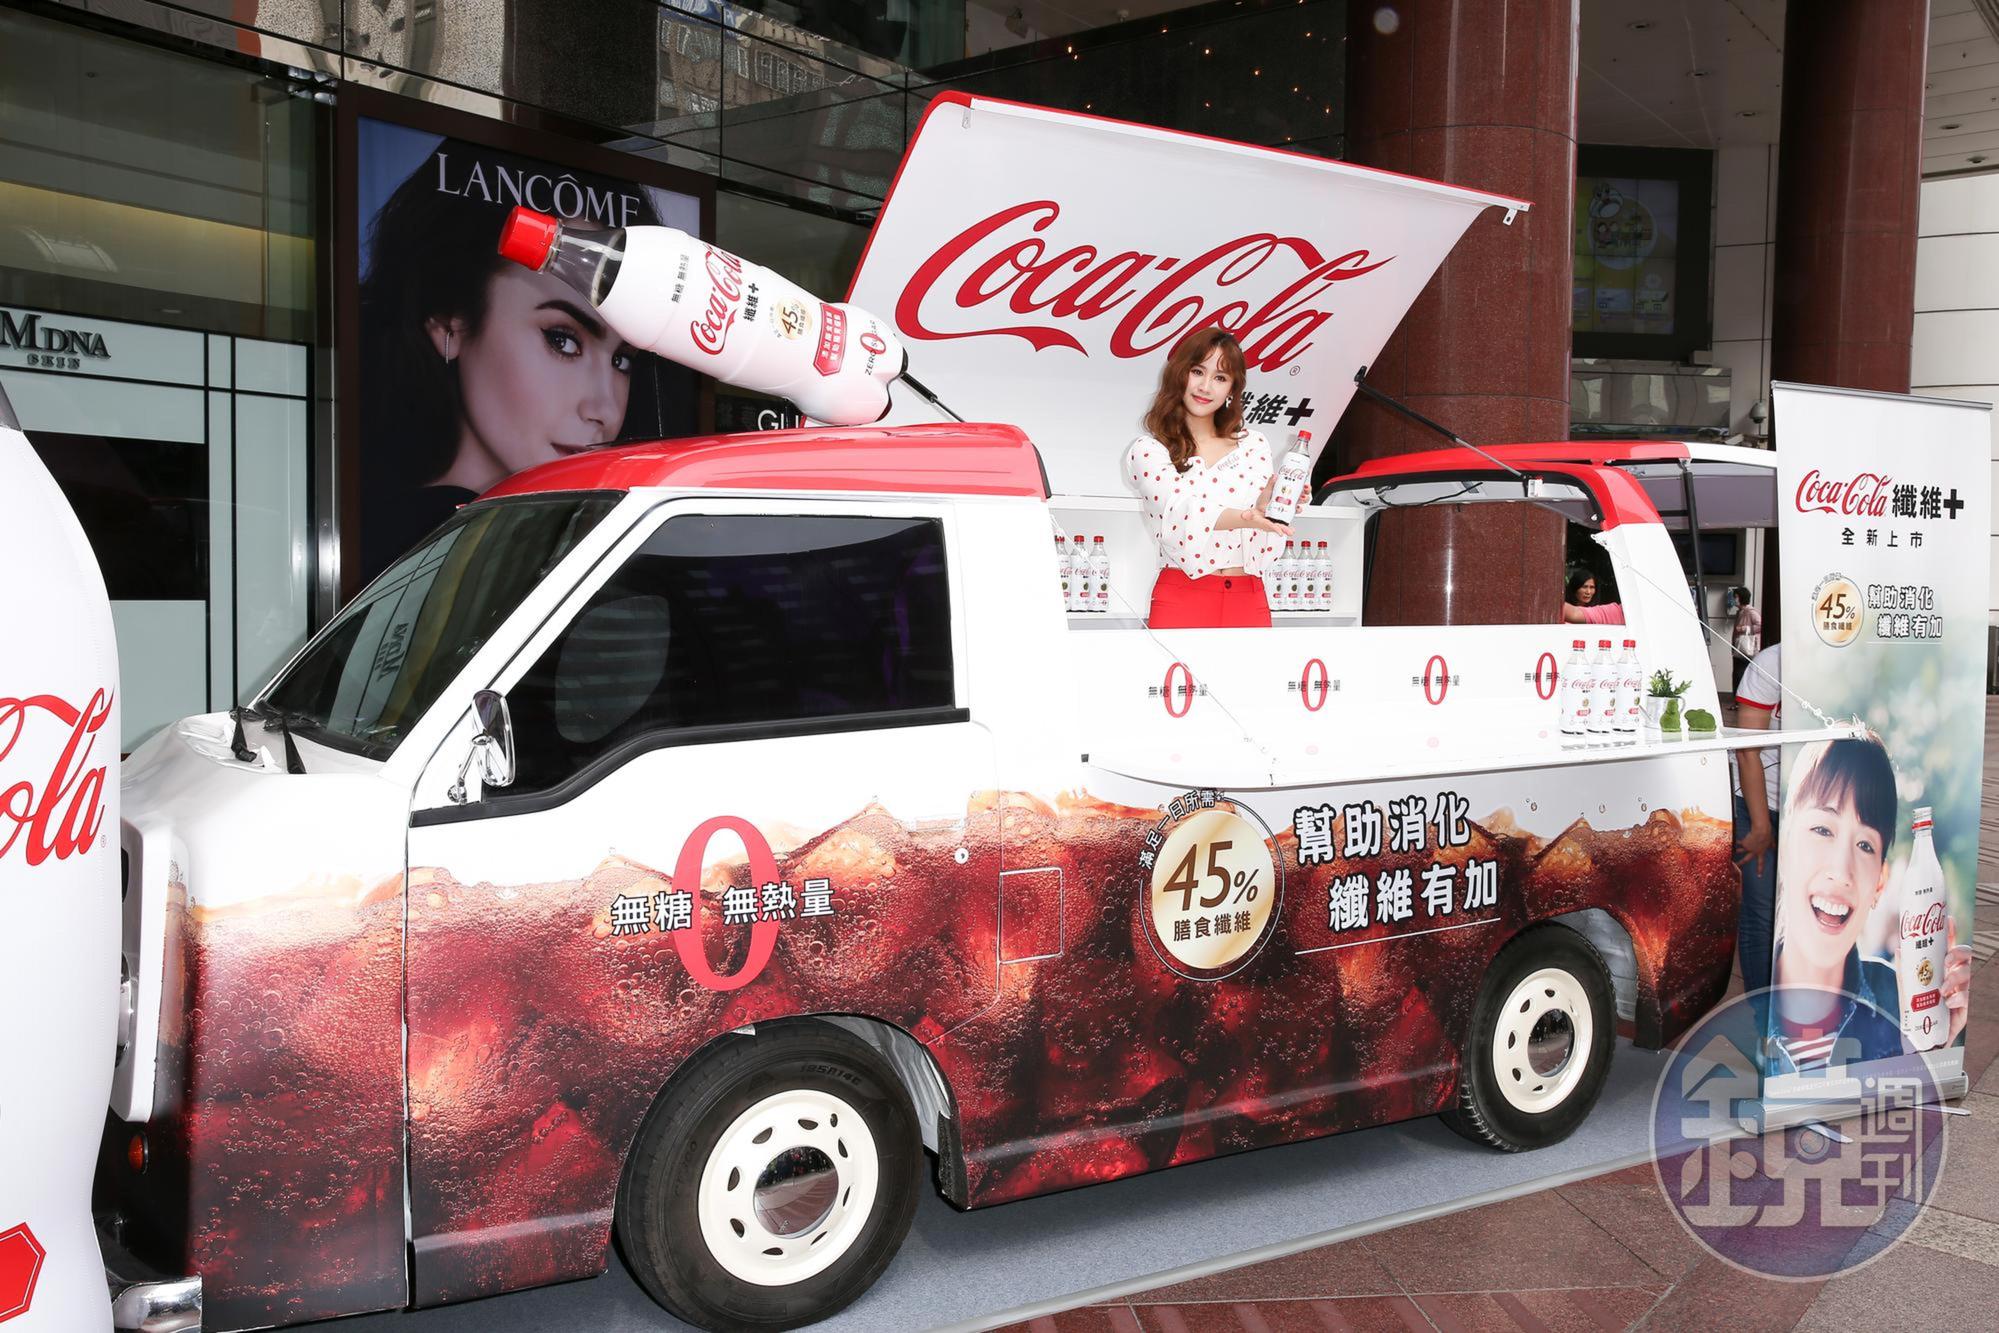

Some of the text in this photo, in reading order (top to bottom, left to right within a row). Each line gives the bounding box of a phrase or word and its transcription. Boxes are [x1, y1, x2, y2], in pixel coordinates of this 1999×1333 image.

[437, 153, 640, 229] LANCÔME
[895, 200, 1397, 373] Coca-Cola
[27, 353, 81, 370] SKIN
[1796, 470, 1893, 517] Coca-Cola
[1842, 528, 1923, 548] 全新上市
[1820, 593, 1855, 620] 45%
[1867, 584, 1934, 610] 幫助消化
[1293, 791, 1473, 867] 幫助消化
[671, 815, 782, 992] 0
[1163, 840, 1259, 912] 45%
[1328, 858, 1500, 932] 纖維有加
[610, 878, 835, 936] 無糖 無熱量
[1173, 910, 1252, 942] 膳食纖維
